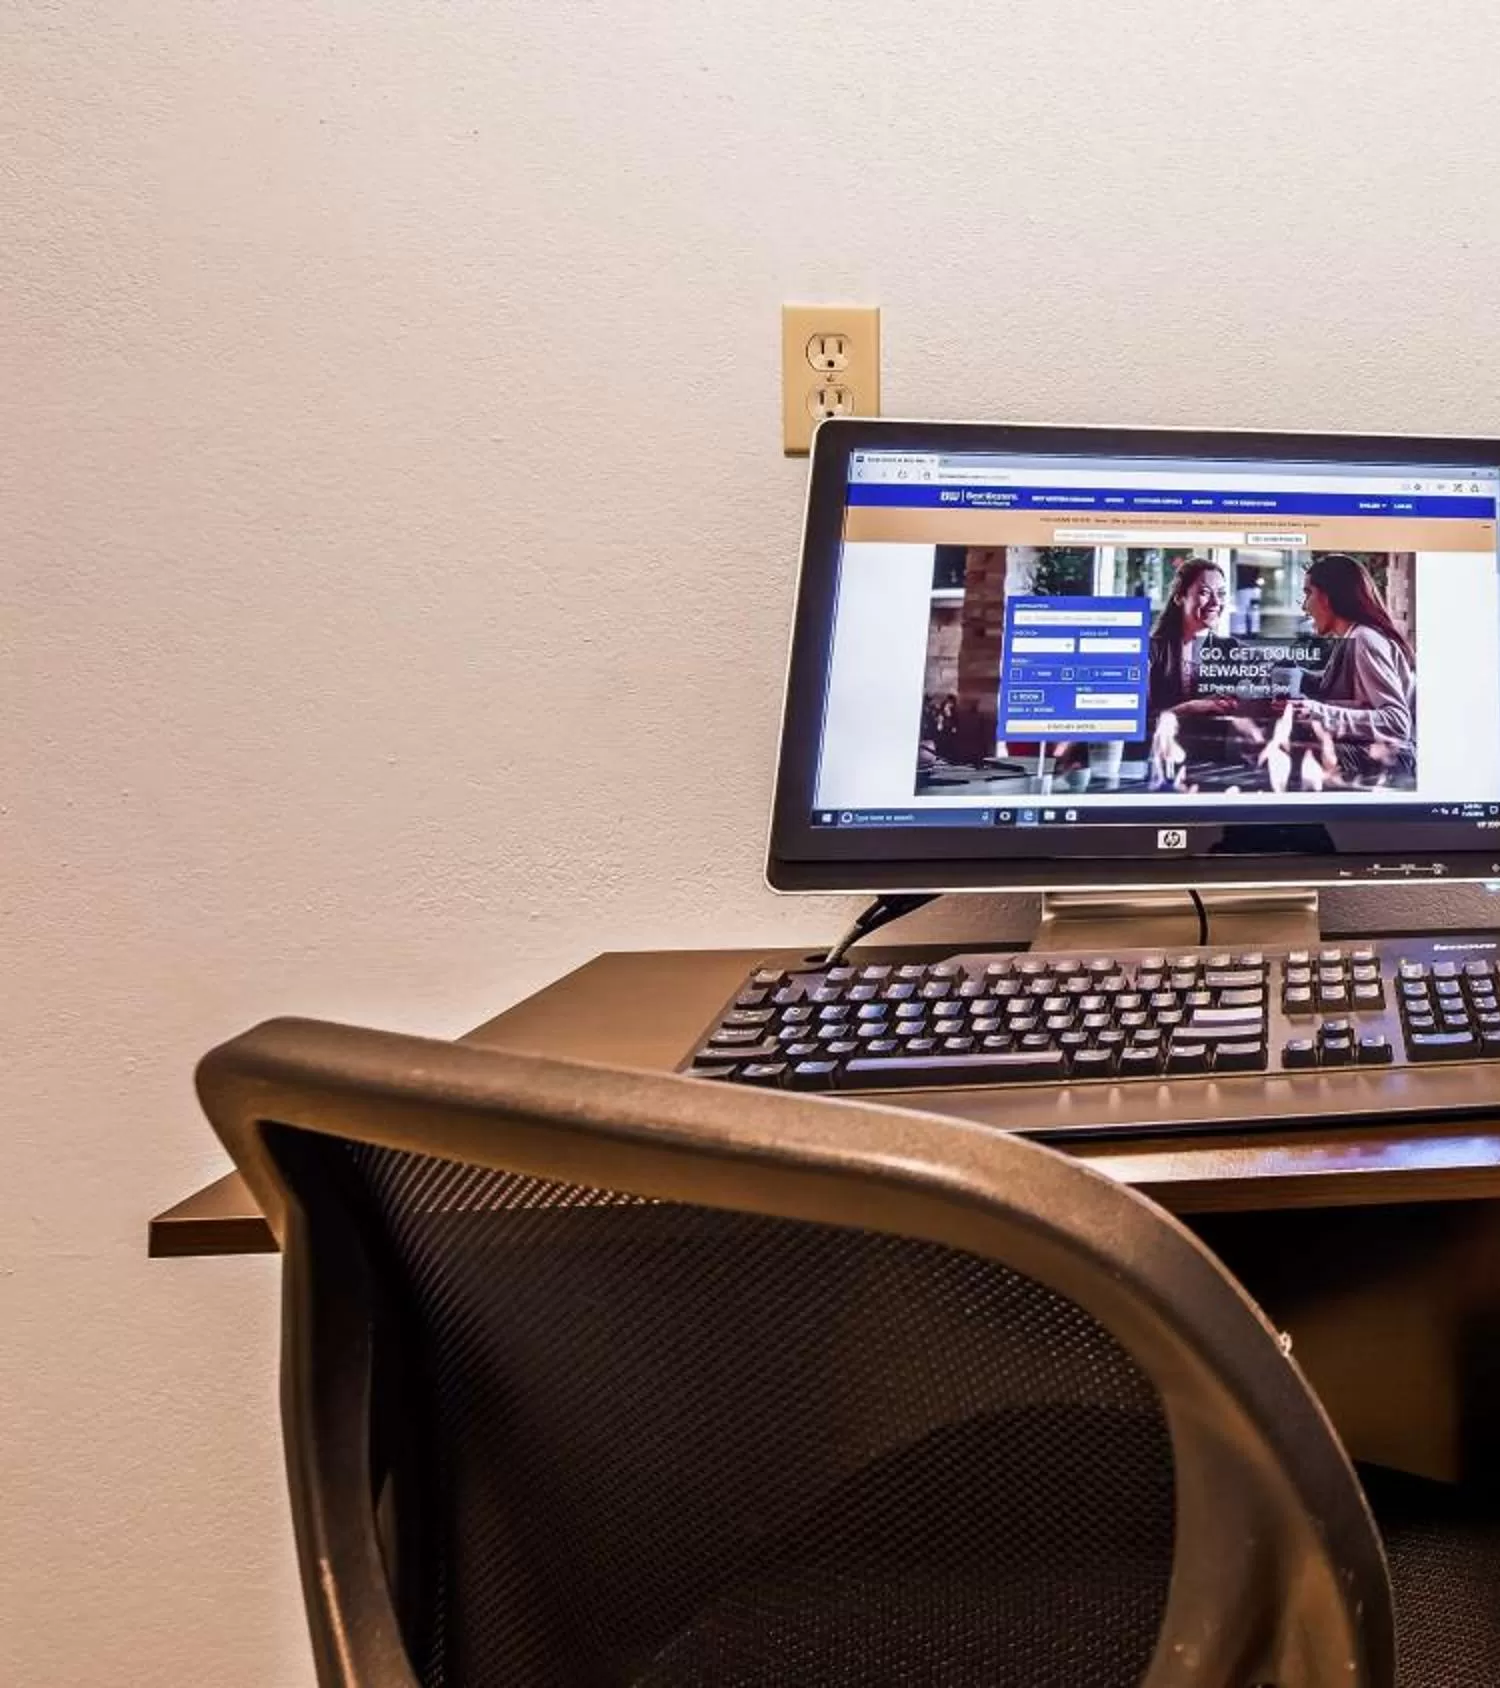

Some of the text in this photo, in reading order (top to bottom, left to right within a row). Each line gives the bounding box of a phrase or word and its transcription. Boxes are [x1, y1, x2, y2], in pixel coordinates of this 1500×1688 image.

[1199, 647, 1321, 661] GO. GET. DOUBLE
